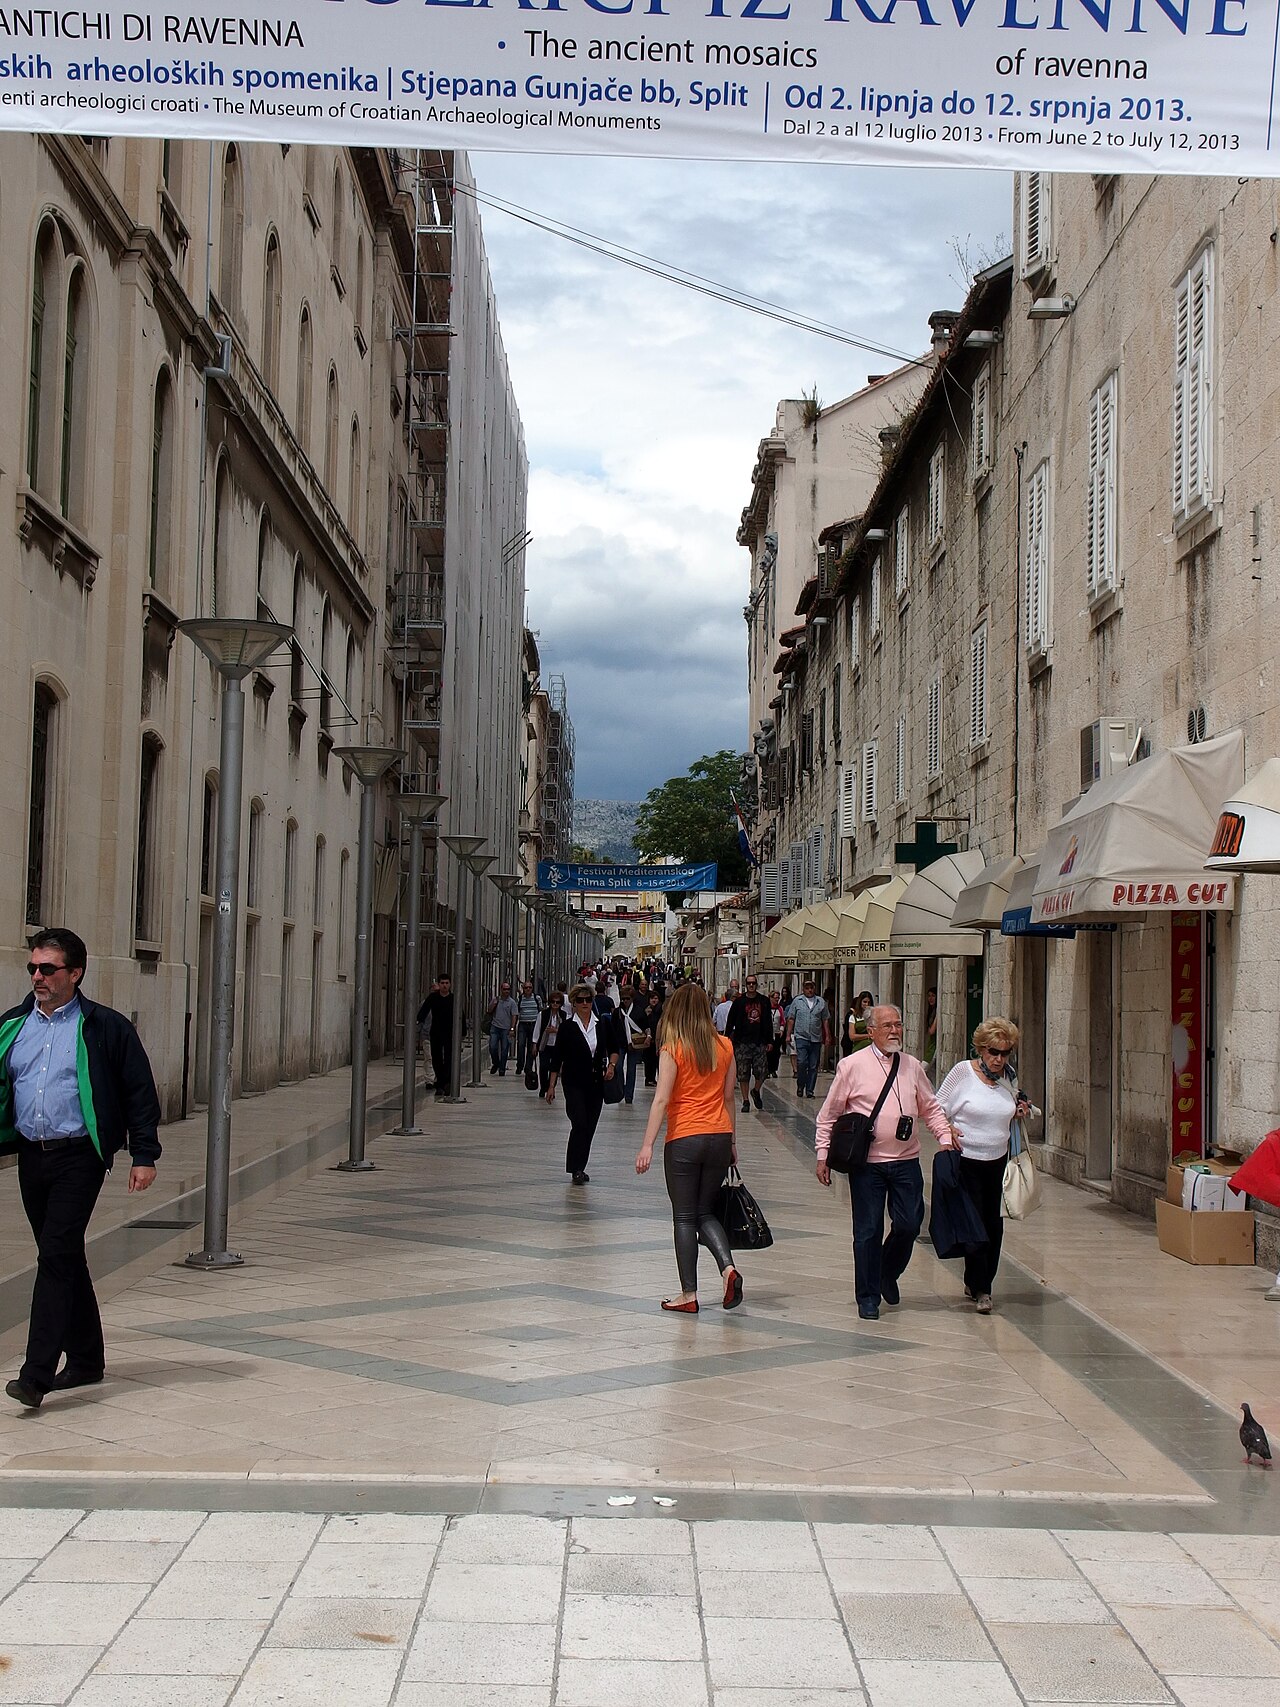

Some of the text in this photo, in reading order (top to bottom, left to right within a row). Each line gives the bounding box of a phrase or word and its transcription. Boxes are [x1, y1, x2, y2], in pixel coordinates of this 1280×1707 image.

[121, 12, 151, 41] DI
[162, 14, 304, 48] RAVENNA
[524, 27, 1147, 79] The ancient mosaics of ravenna
[0, 52, 748, 111] skih arheoloških spomenika Stjepana Gunjače bb, Split
[2, 89, 660, 130] enti archeologici croati The Museum of Croatian Archaeological Monuments
[785, 85, 1191, 124] Od 2. lipnja do 12. srpnja 2013.
[784, 119, 1239, 151] Dal 2 a al 12 luglio 2013 From June 2 to July 12, 2013
[577, 867, 695, 877] Festival Mediteranskog
[577, 878, 605, 887] Filma
[608, 878, 631, 889] Split
[1112, 883, 1228, 905] PIZZA CUT
[1178, 1073, 1194, 1137] CUT
